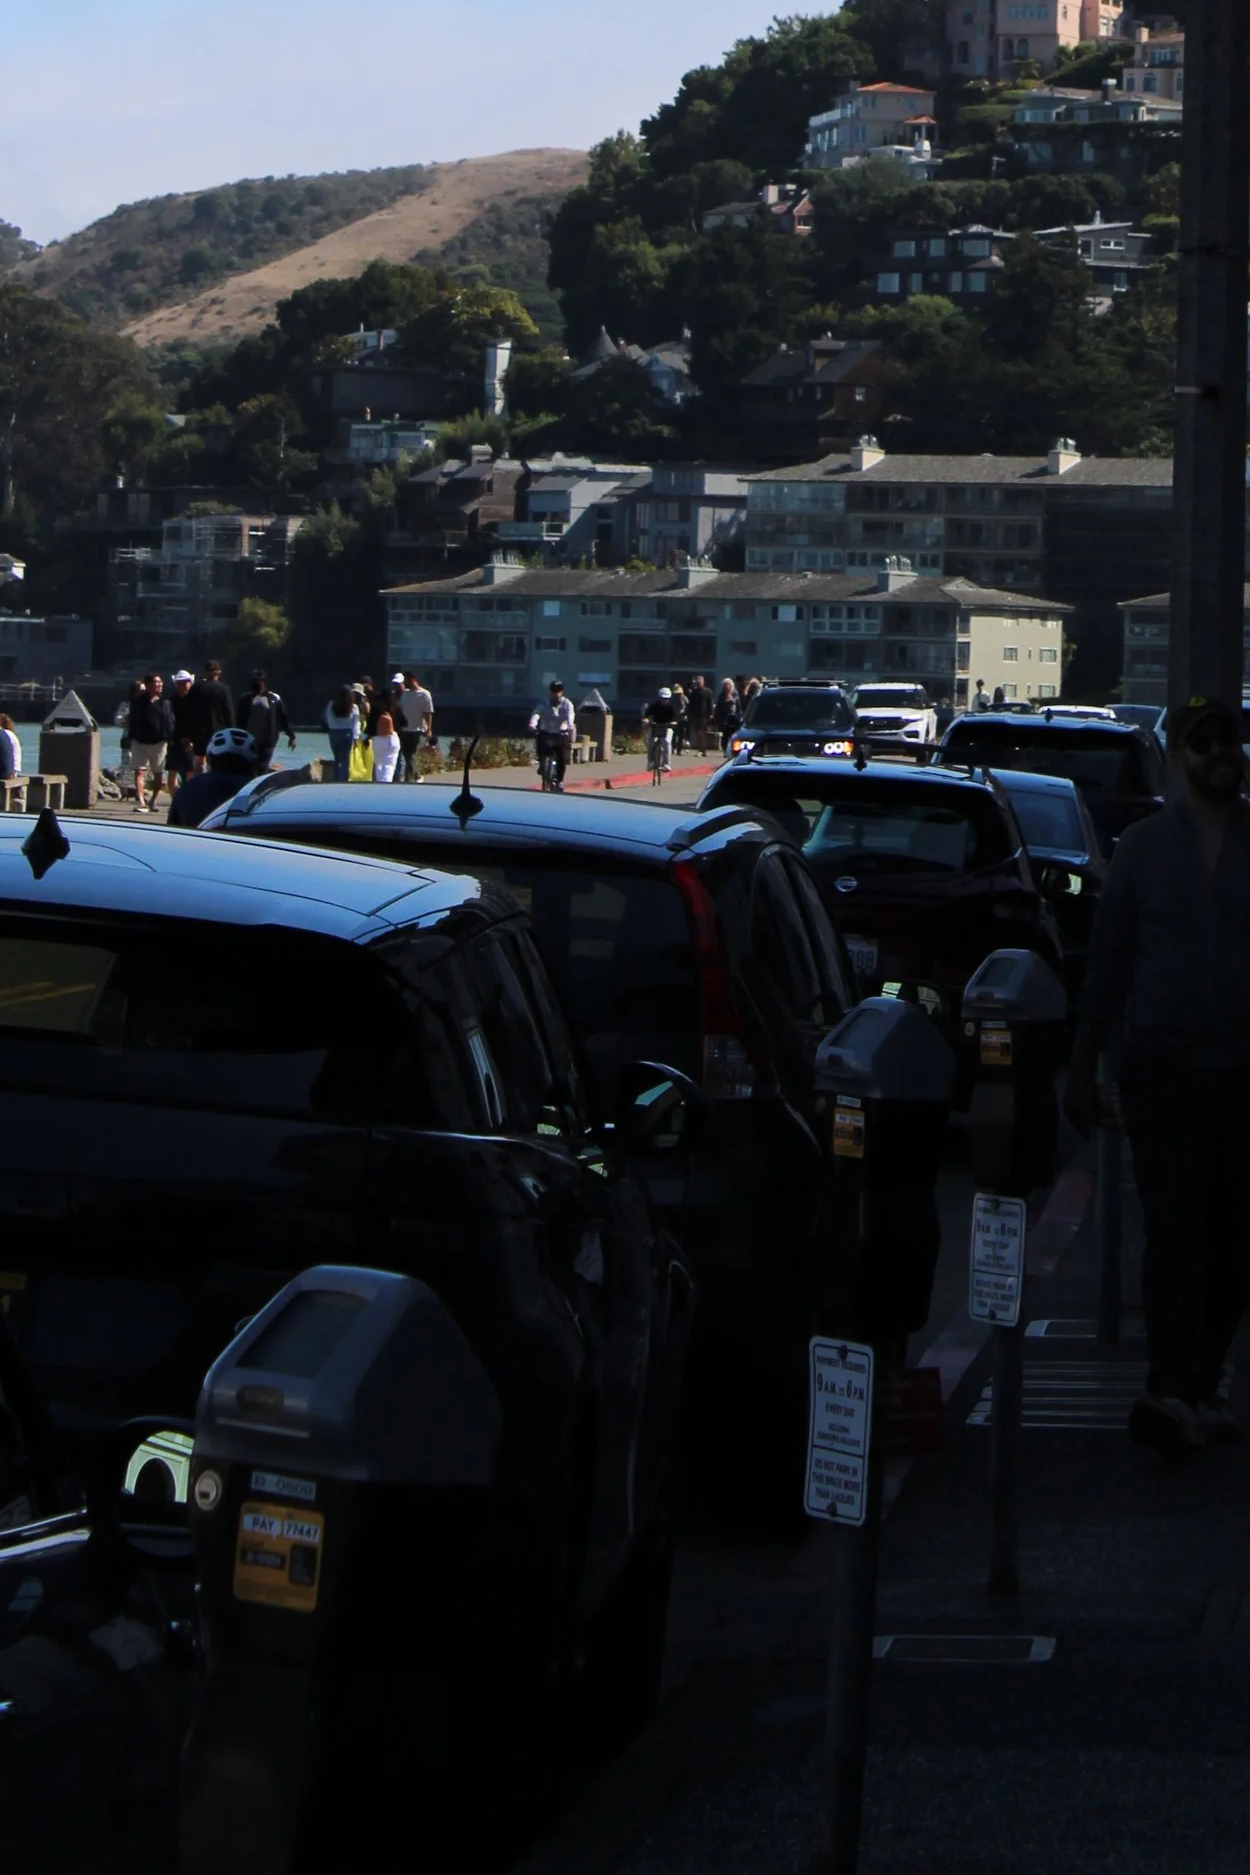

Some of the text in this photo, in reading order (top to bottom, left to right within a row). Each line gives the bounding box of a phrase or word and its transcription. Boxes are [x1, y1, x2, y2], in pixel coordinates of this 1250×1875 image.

[1000, 1222, 1006, 1236] 6
[817, 1372, 823, 1392] 9
[846, 1379, 852, 1398] 6
[824, 1460, 836, 1472] NOT
[836, 1463, 851, 1475] PARK
[825, 1475, 842, 1489] SPACE
[843, 1480, 861, 1493] MORE
[251, 1516, 319, 1540] PAY 77447
